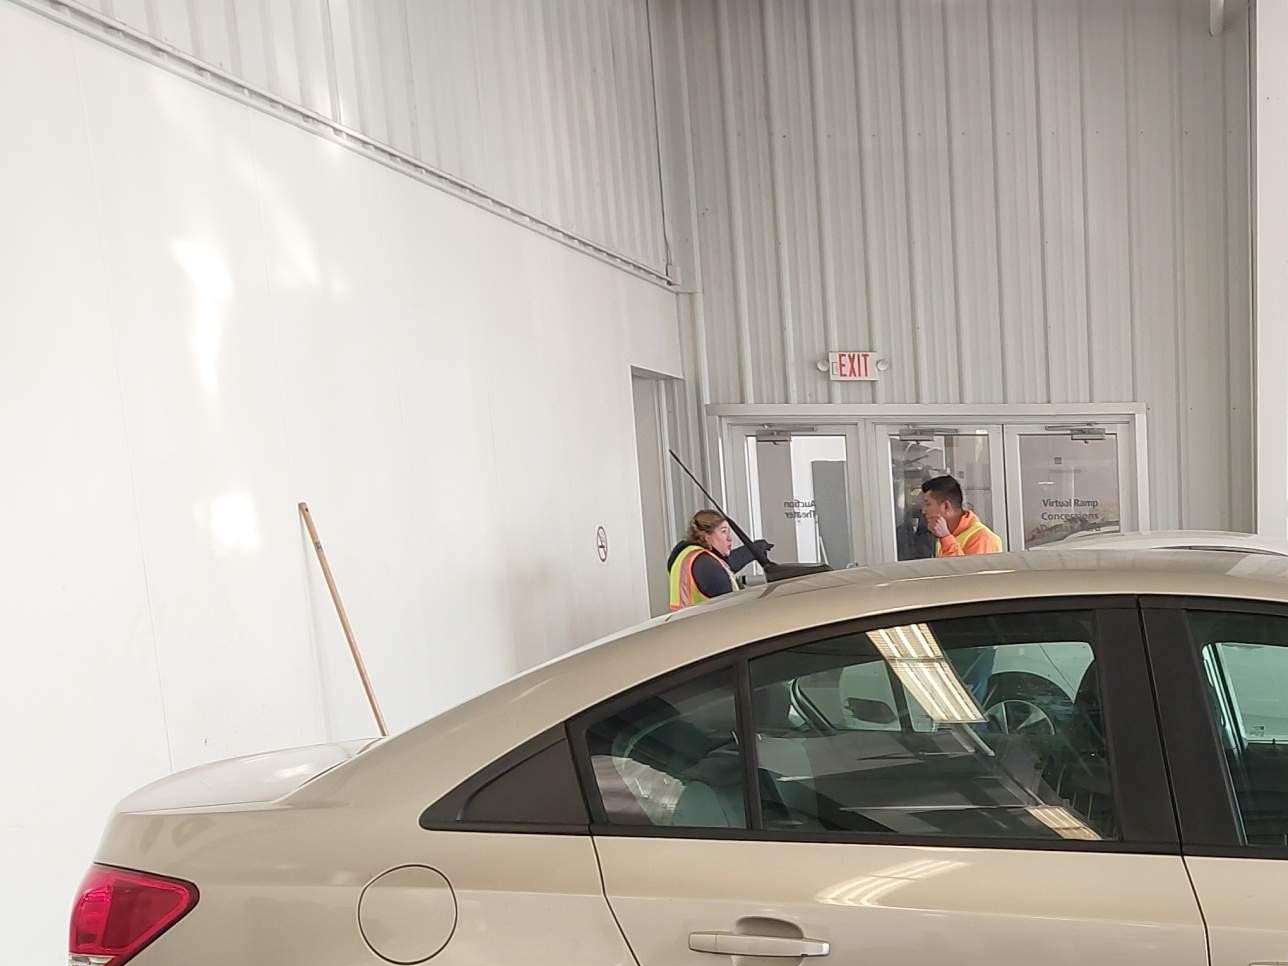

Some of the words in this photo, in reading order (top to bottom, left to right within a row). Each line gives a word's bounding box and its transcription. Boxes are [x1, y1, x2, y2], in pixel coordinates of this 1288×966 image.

[838, 353, 870, 377] EXIT
[1042, 498, 1073, 508] Virtual
[1073, 498, 1099, 509] Ramp
